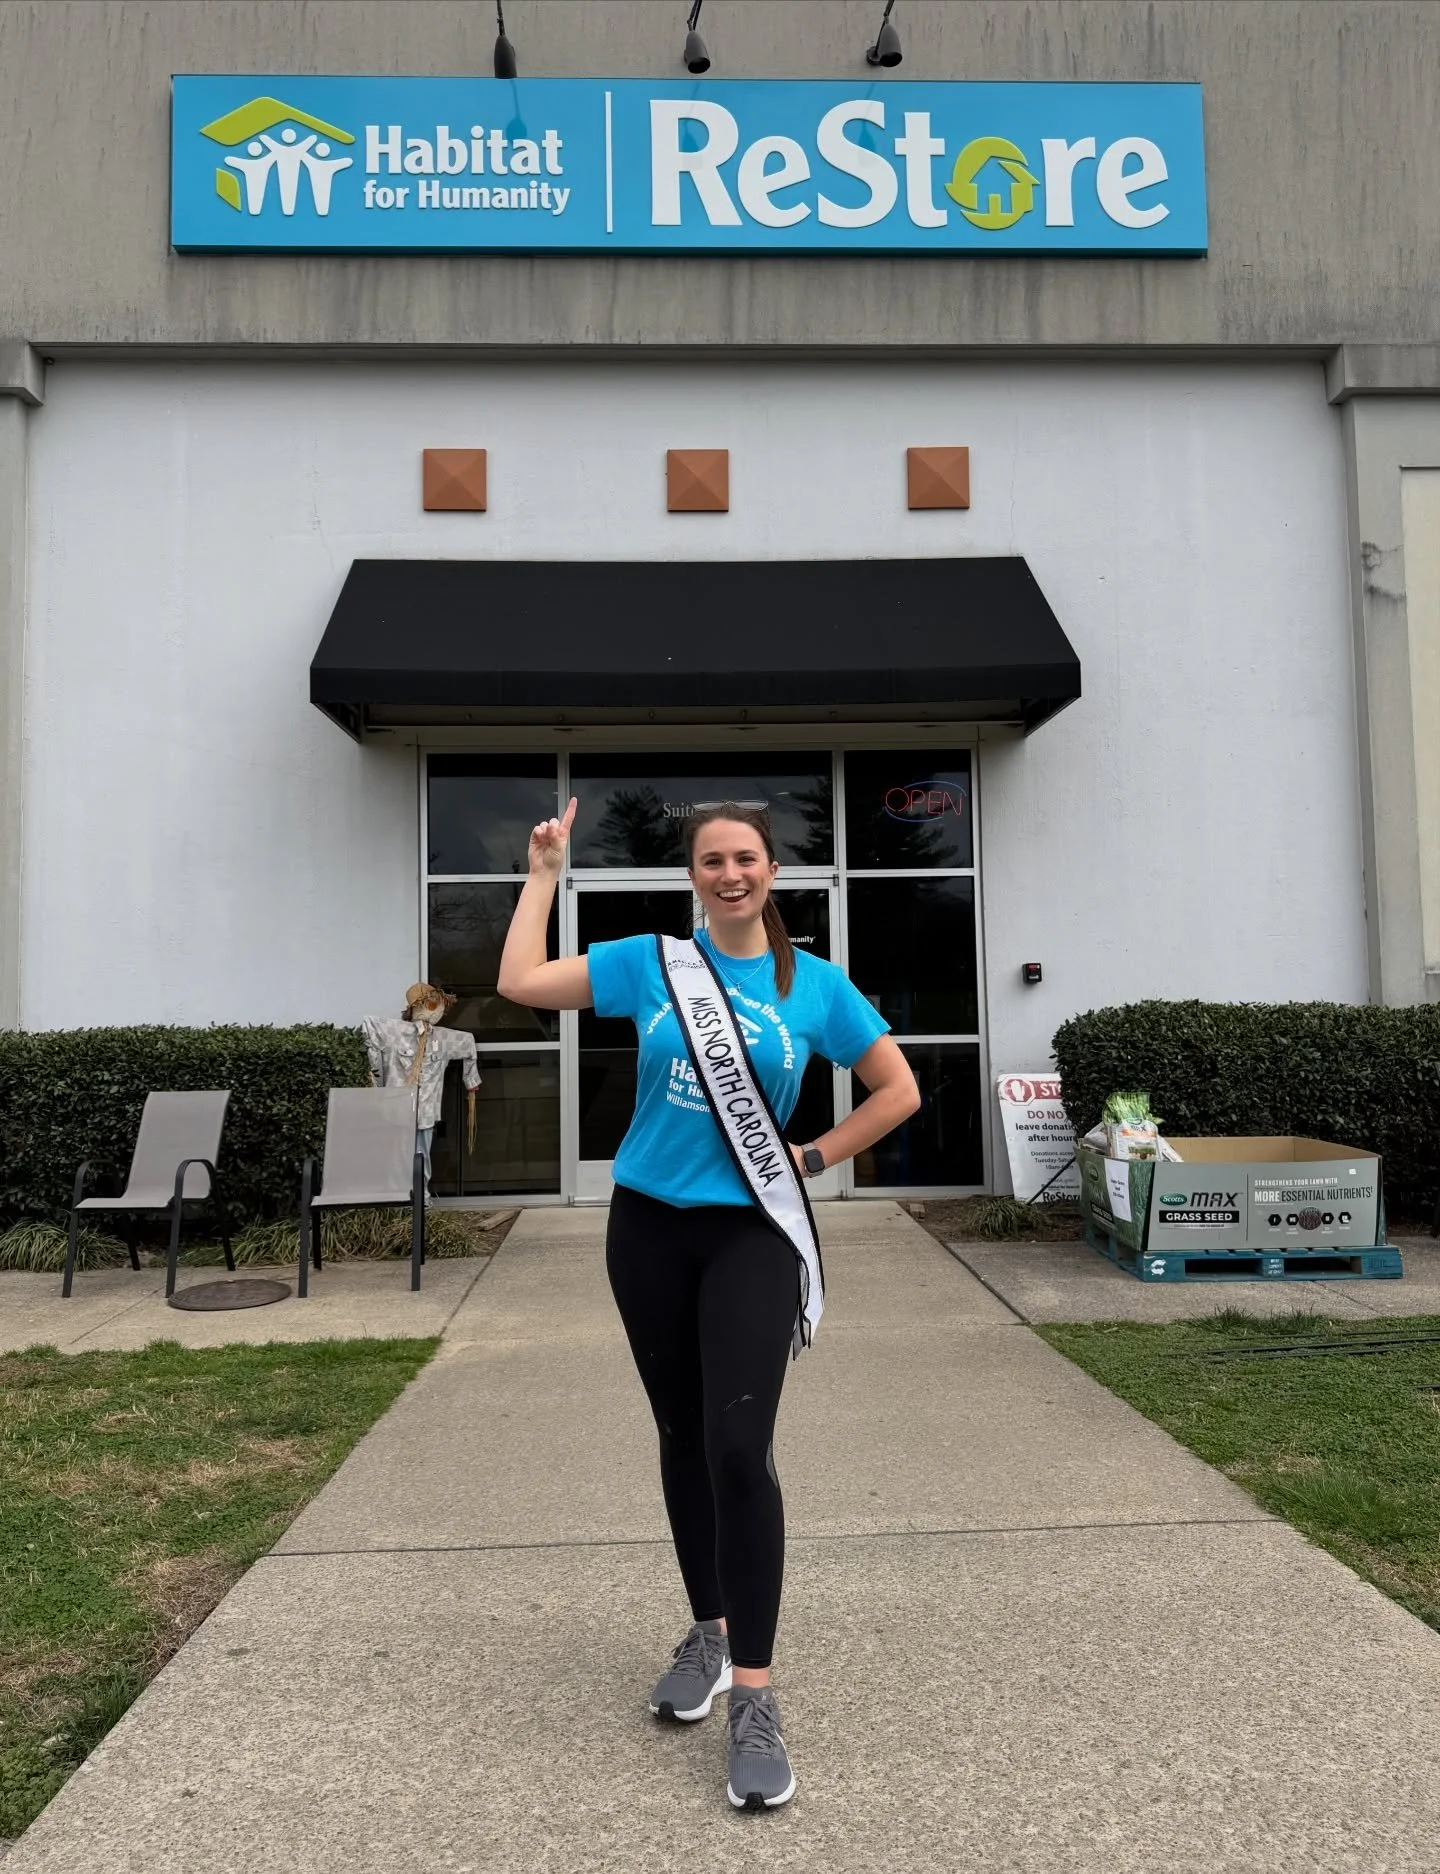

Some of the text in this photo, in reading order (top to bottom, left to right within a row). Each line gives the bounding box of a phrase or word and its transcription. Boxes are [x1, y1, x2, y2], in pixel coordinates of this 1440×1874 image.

[364, 124, 565, 175] Habitat
[649, 99, 1170, 231] ReStore
[363, 180, 571, 216] for Humanity
[885, 787, 963, 816] OPEN
[687, 996, 722, 1029] MISS
[760, 1003, 782, 1025] the
[777, 1023, 796, 1070] world
[700, 1028, 746, 1096] NORTH
[668, 1077, 685, 1093] for
[1027, 1110, 1045, 1120] DO
[1015, 1122, 1040, 1131] leave
[1027, 1133, 1051, 1142] after
[726, 1094, 784, 1188] CAROLINA
[1254, 1179, 1293, 1187] STRENGTHENS
[1293, 1178, 1309, 1186] YOUR
[1162, 1191, 1239, 1207] Scotts MAX
[1254, 1190, 1280, 1202] MORE
[1281, 1189, 1326, 1202] ESSENTIAL
[1165, 1212, 1233, 1221] GRASS SEED
